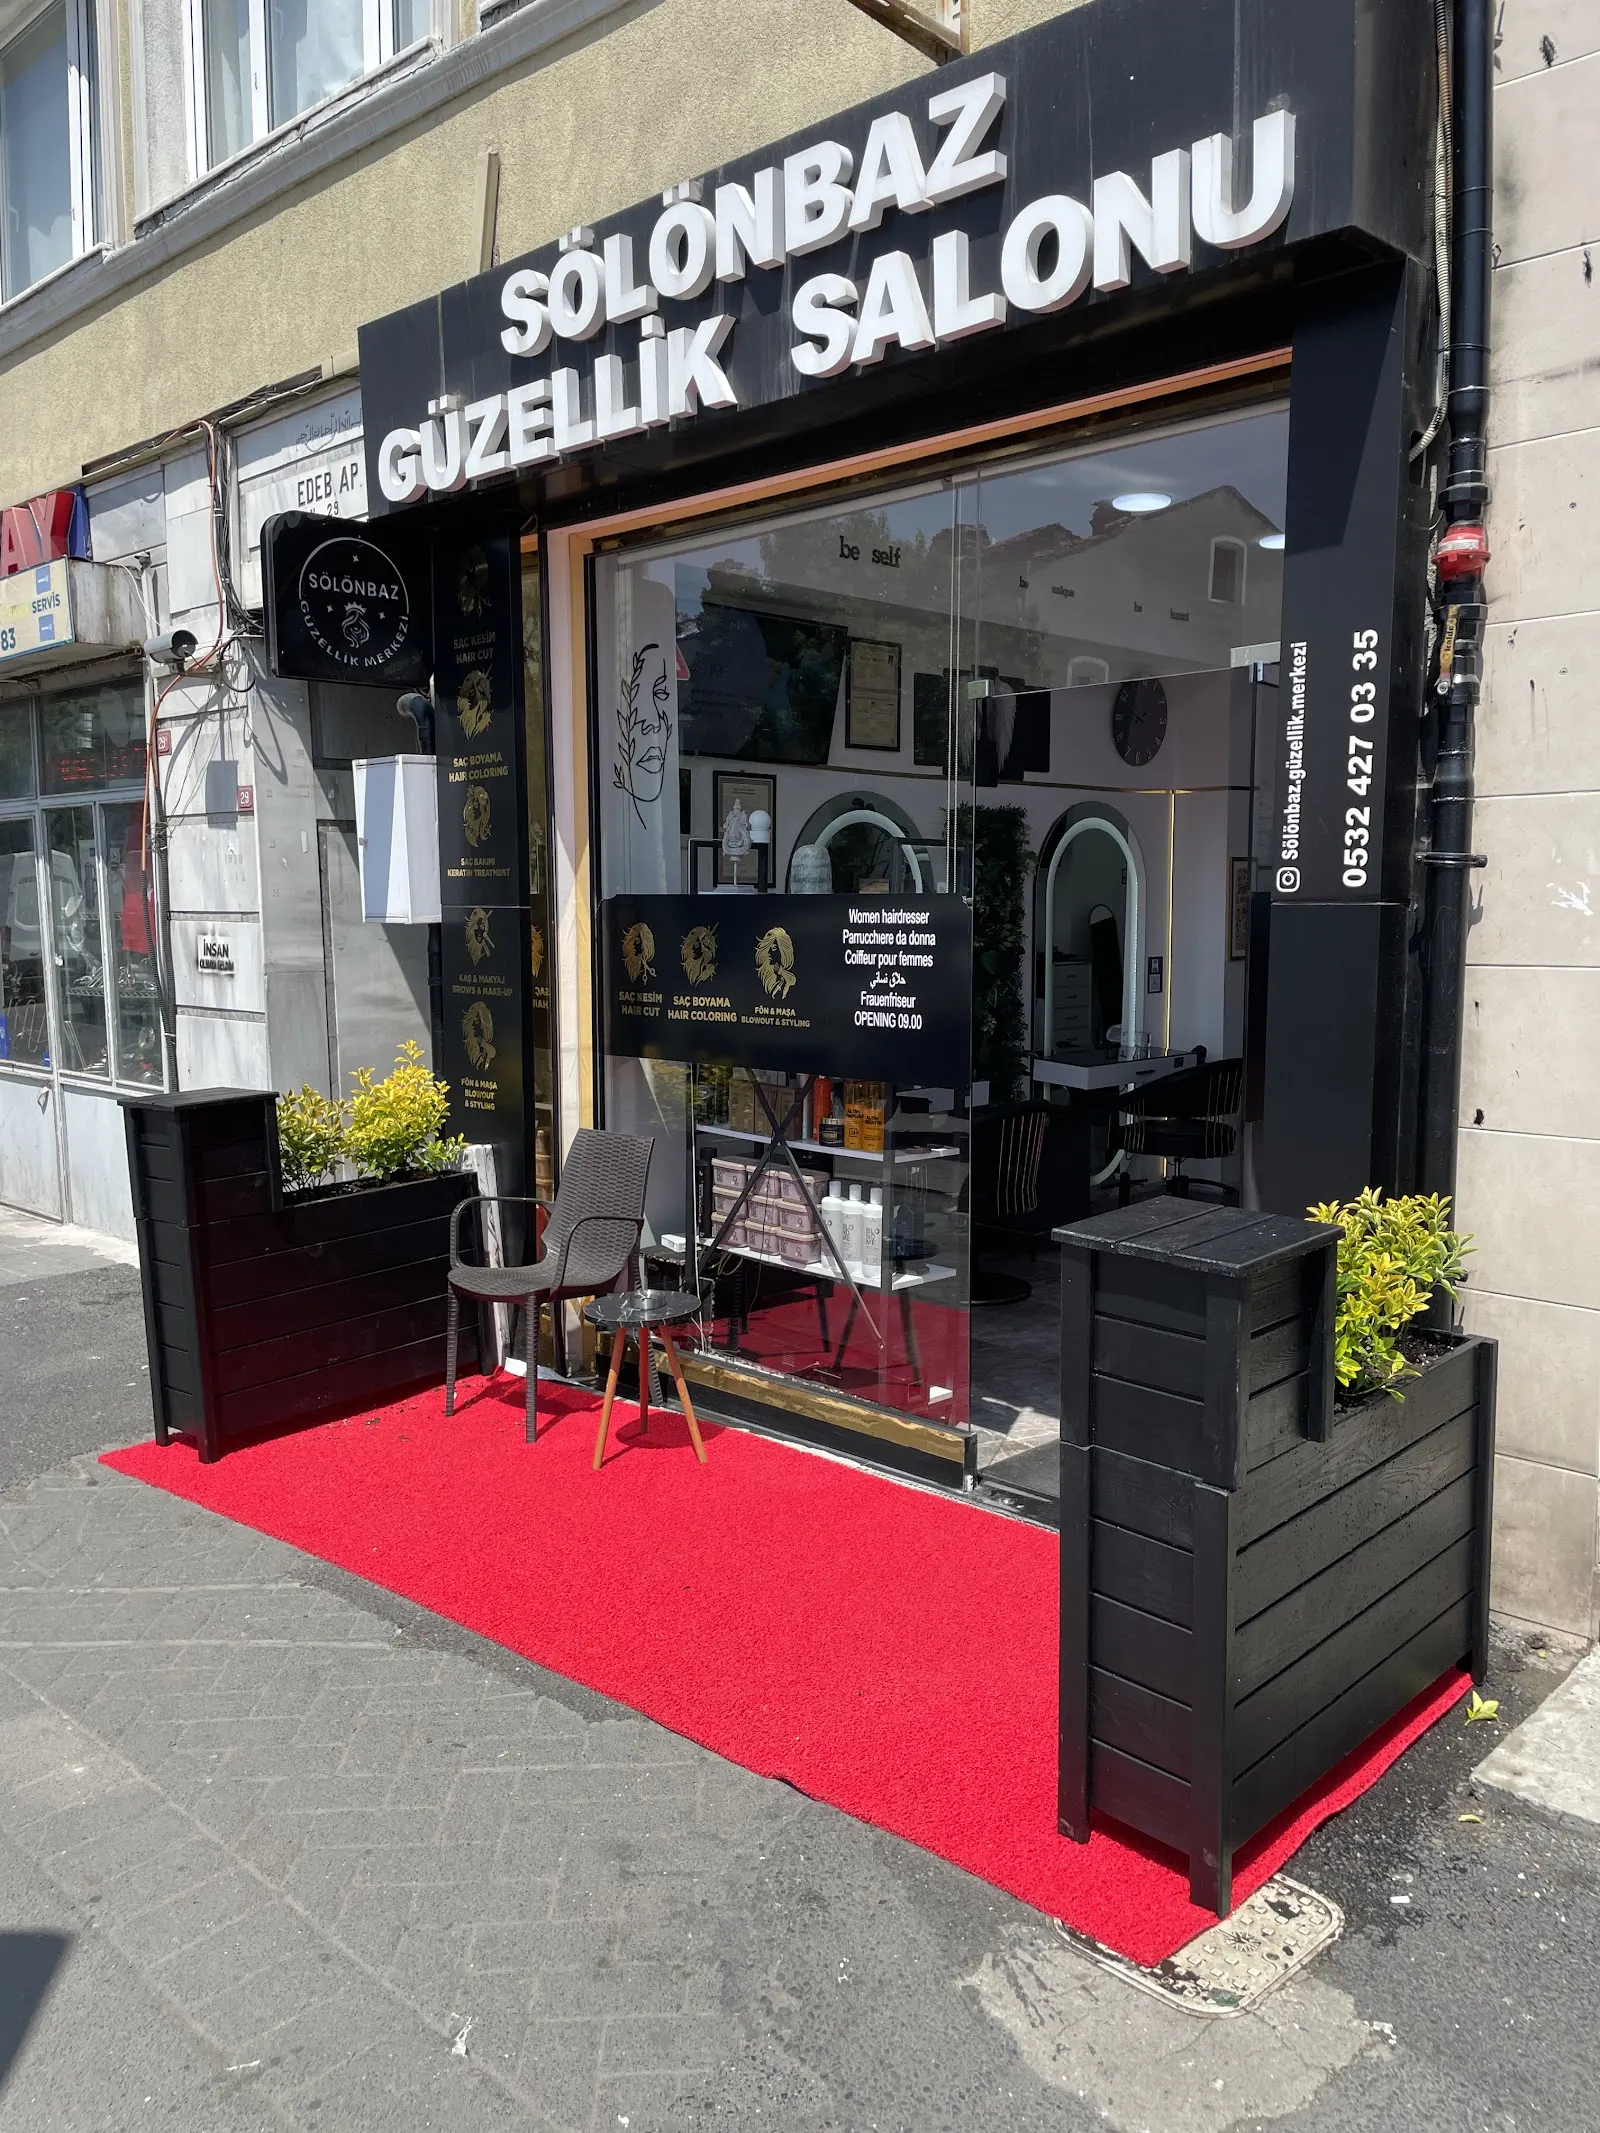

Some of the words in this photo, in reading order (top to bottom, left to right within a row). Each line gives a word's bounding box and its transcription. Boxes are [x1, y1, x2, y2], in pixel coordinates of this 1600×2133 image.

[500, 71, 1007, 357] SÖLÖNBAZ
[377, 313, 738, 503] GÜZELLİK
[790, 109, 1296, 379] SALONU
[298, 472, 332, 507] EDEB
[839, 535, 860, 560] be
[872, 545, 901, 568] self
[308, 571, 399, 600] SÖLÖNBAZ
[32, 593, 61, 613] SERVİS
[1352, 629, 1379, 670] 35
[1350, 681, 1376, 723] 03
[453, 757, 468, 768] SAÇ
[470, 751, 503, 766] BOYAMA
[1347, 736, 1374, 796] 427
[448, 771, 468, 783] HAIR
[468, 766, 509, 780] COLORING
[240, 791, 249, 805] 29
[1342, 806, 1371, 888] 0532
[848, 908, 880, 924] Women
[882, 908, 930, 924] hairdresser
[895, 929, 907, 945] da
[908, 930, 936, 945] donna
[203, 939, 229, 958] İNSAN
[844, 949, 877, 965] Coiffeur
[878, 953, 898, 969] pour
[899, 951, 934, 967] femmes
[618, 991, 636, 1004] SAÇ
[637, 991, 663, 1003] KESİM
[673, 995, 691, 1008] SAÇ
[693, 996, 731, 1008] BOYAMA
[860, 990, 916, 1008] Frauenfriseur
[622, 1005, 641, 1016] HAIR
[643, 1006, 660, 1017] CUT
[668, 1010, 689, 1021] HAIR
[691, 1010, 737, 1022] COLORING
[741, 1016, 774, 1025] BLOWOUT
[781, 1019, 811, 1028] STYLING
[854, 1011, 897, 1028] OPENING
[898, 1013, 922, 1030] 09.00
[465, 1089, 495, 1100] BLOWOUT
[470, 1101, 496, 1111] STYLING
